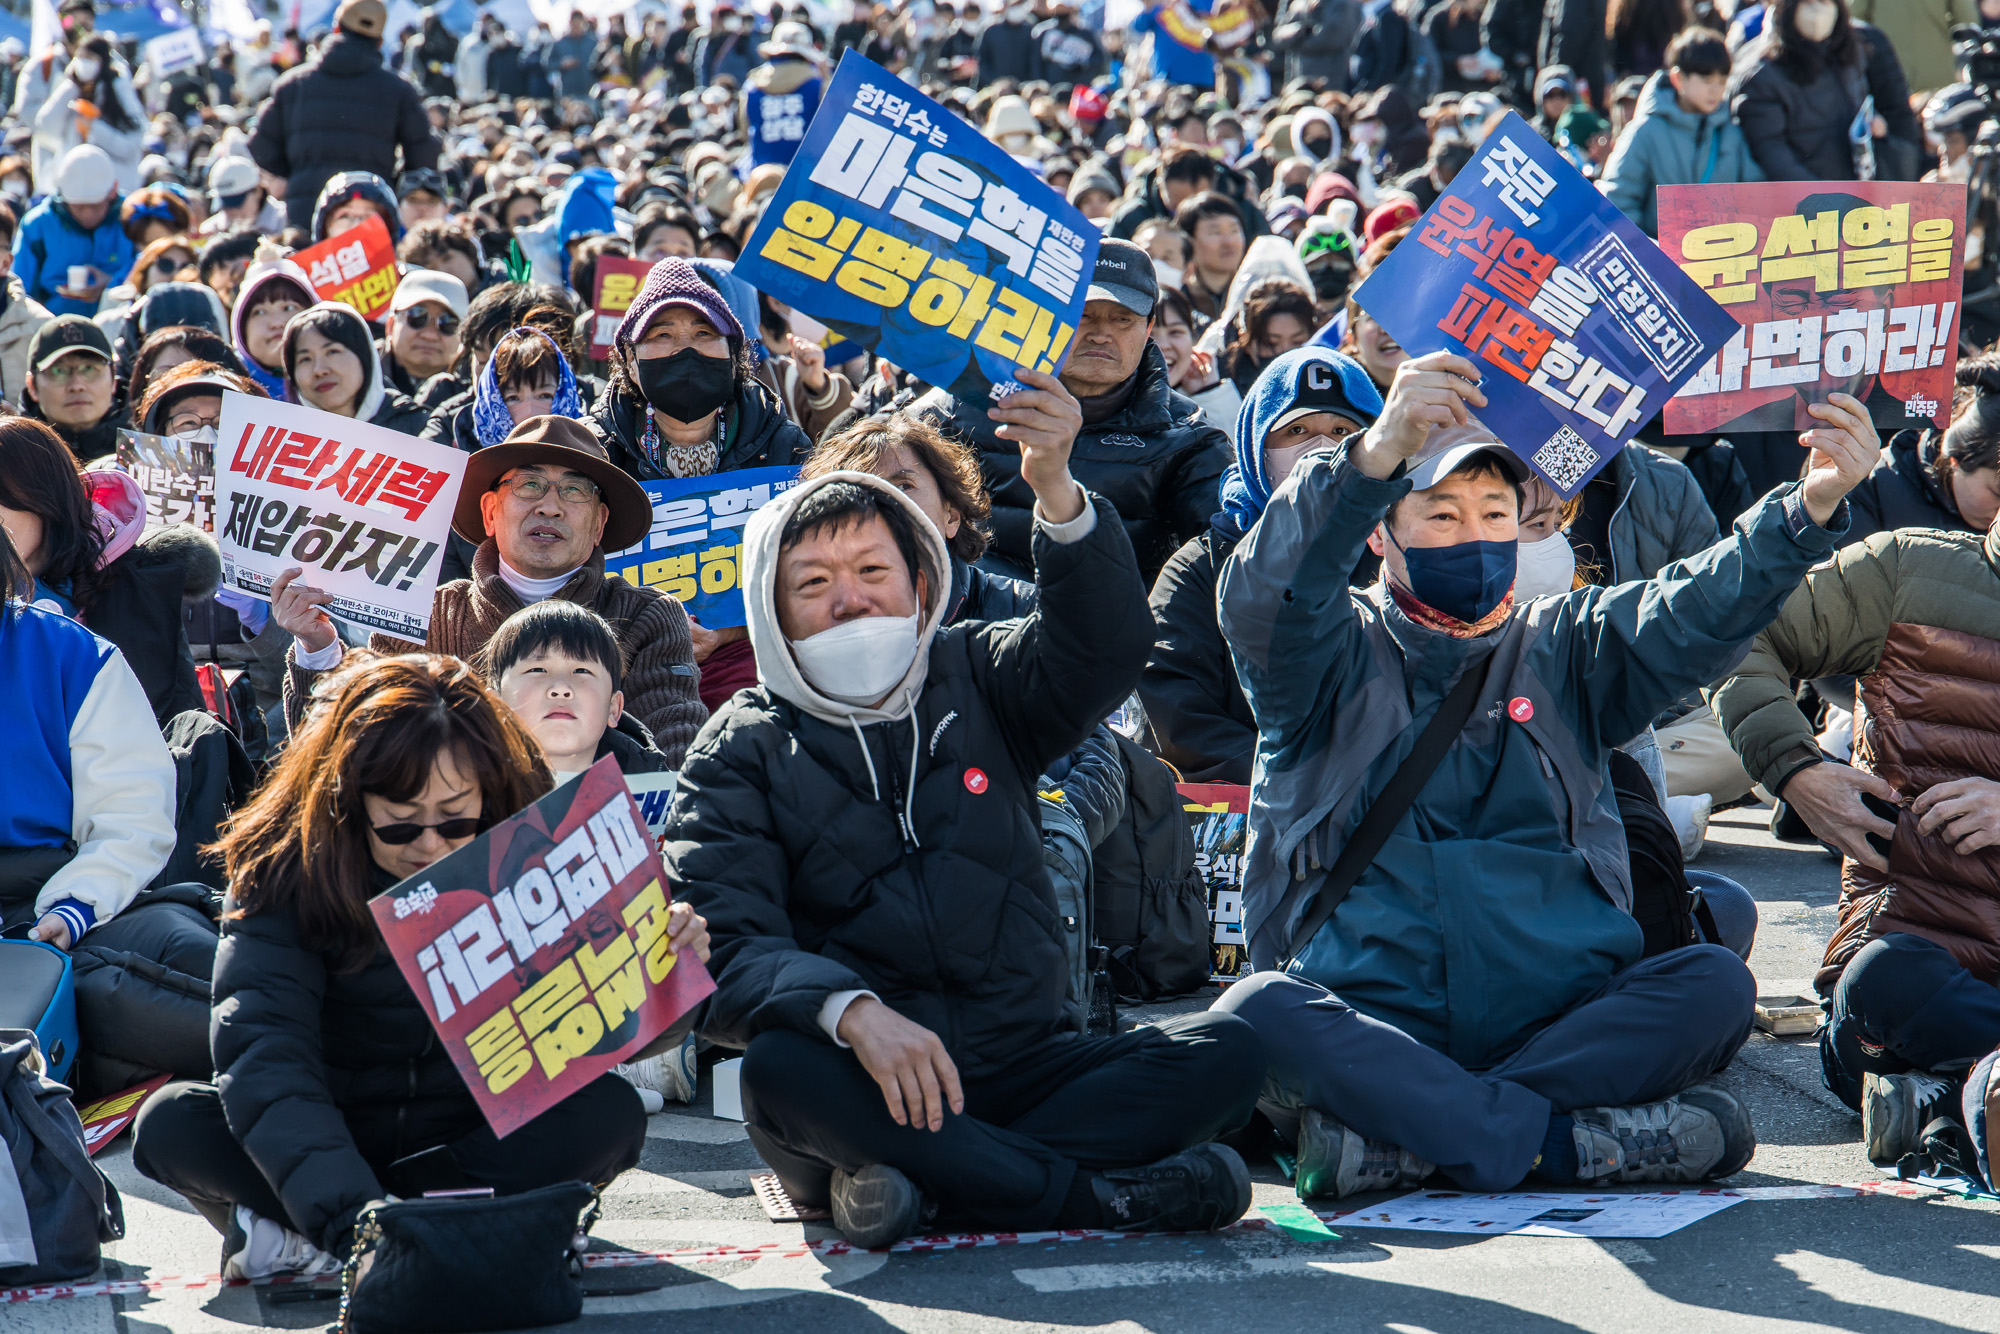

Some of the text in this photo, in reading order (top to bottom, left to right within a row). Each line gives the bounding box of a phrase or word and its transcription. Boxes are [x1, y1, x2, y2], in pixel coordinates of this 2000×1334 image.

[852, 83, 949, 149] 한덕수는
[309, 239, 371, 288] 석열
[759, 200, 1075, 376] 임명하라!
[1416, 194, 1601, 338] 윤석열을
[1679, 202, 1954, 305] 윤석열을
[1597, 258, 1687, 361] 만장일치
[1307, 362, 1333, 390] C
[1436, 281, 1648, 440] 파면한다
[1904, 400, 1938, 418] 민주당
[229, 422, 451, 522] 내란세력
[223, 491, 440, 592] 제압하자!
[372, 607, 400, 620] 모이자!
[416, 791, 649, 1023] 파면하라!
[1194, 853, 1245, 885] 윤석
[464, 877, 679, 1095] 윤석열을
